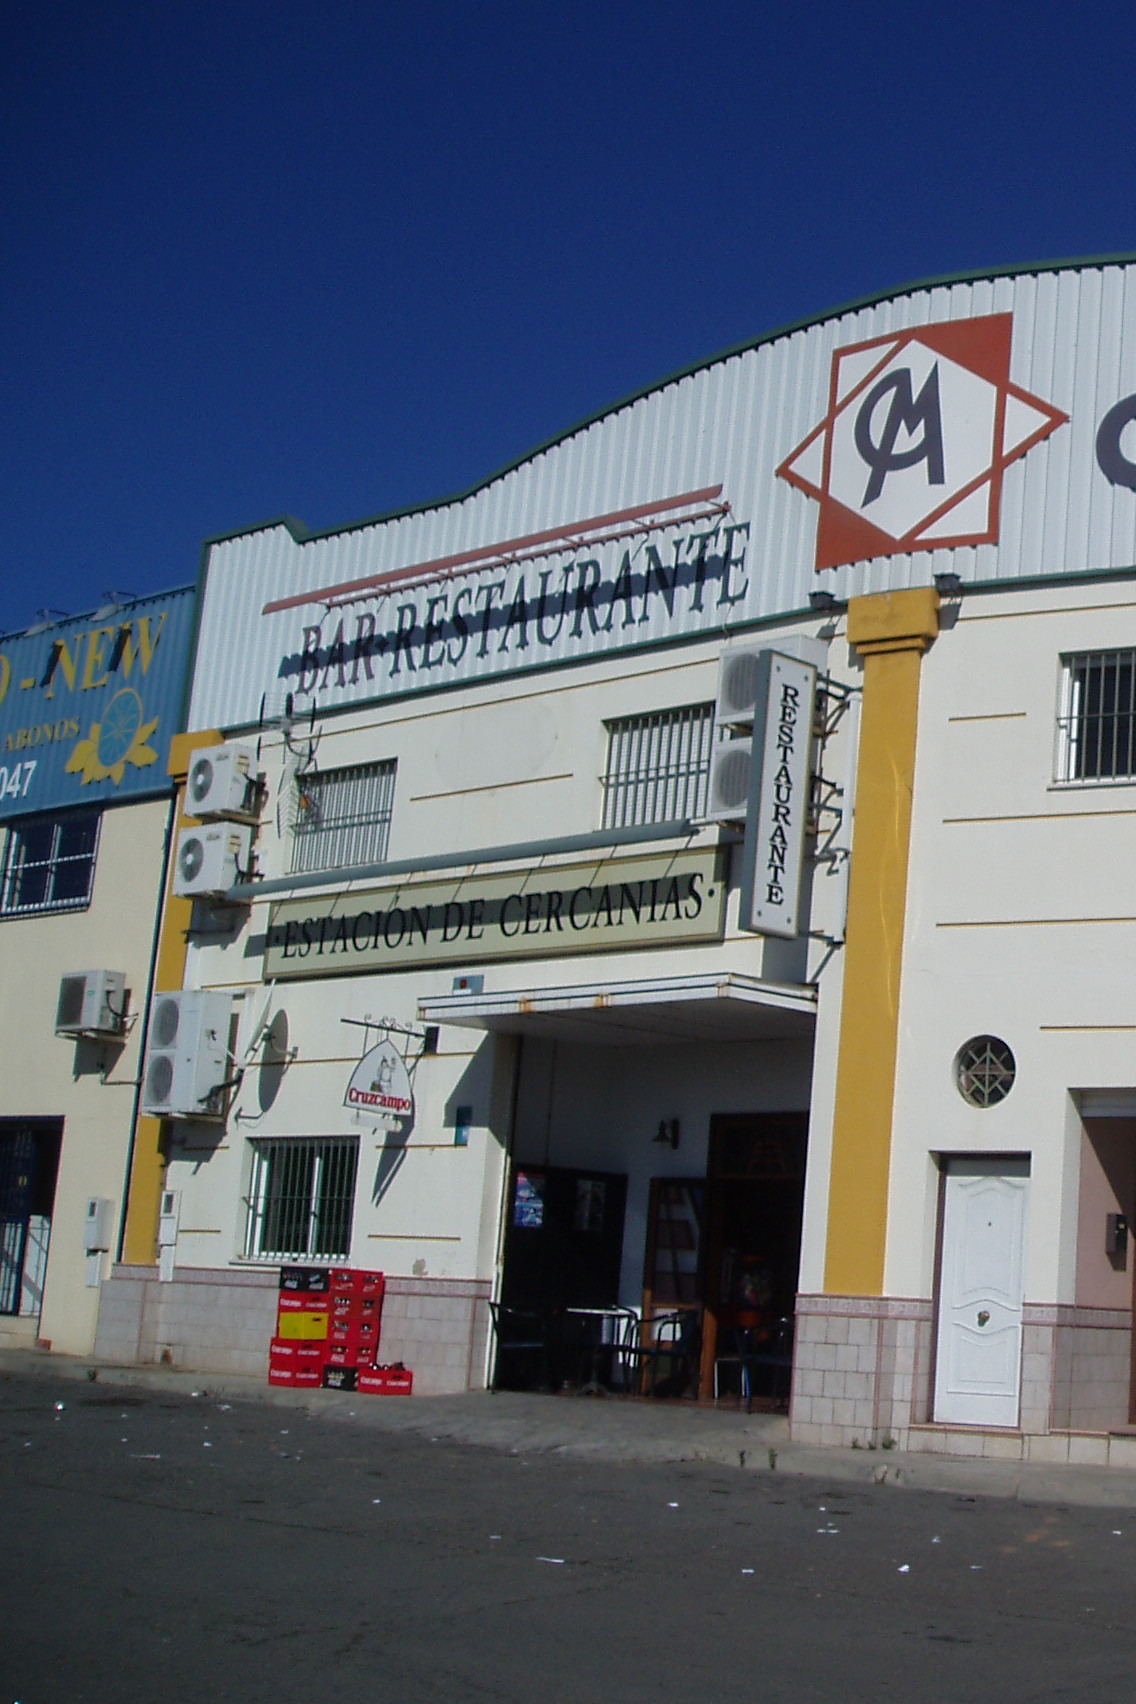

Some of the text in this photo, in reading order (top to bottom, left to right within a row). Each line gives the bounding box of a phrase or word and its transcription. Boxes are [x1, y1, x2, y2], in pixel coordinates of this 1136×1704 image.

[294, 520, 751, 695] BAR RESTAURANTE
[764, 683, 800, 906] RESTAURANTE
[440, 898, 486, 943] DE
[348, 1087, 412, 1112] Cruzcampo
